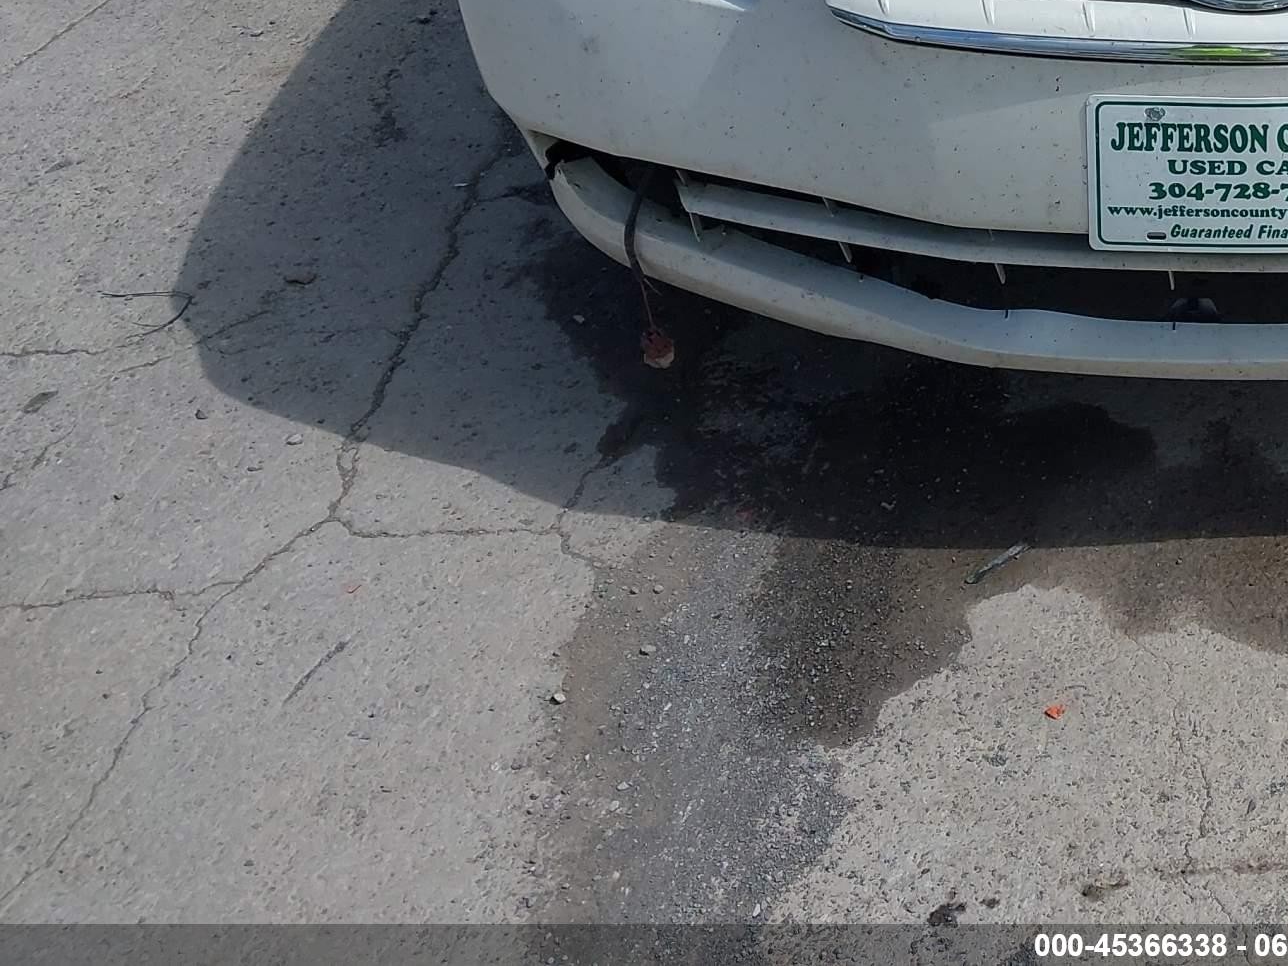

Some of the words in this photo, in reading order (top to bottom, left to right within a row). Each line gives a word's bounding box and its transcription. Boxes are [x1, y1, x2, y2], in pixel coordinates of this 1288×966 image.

[1110, 121, 1269, 154] JEFFERSON
[1167, 159, 1248, 176] USED
[1169, 224, 1252, 240] Guaranteed
